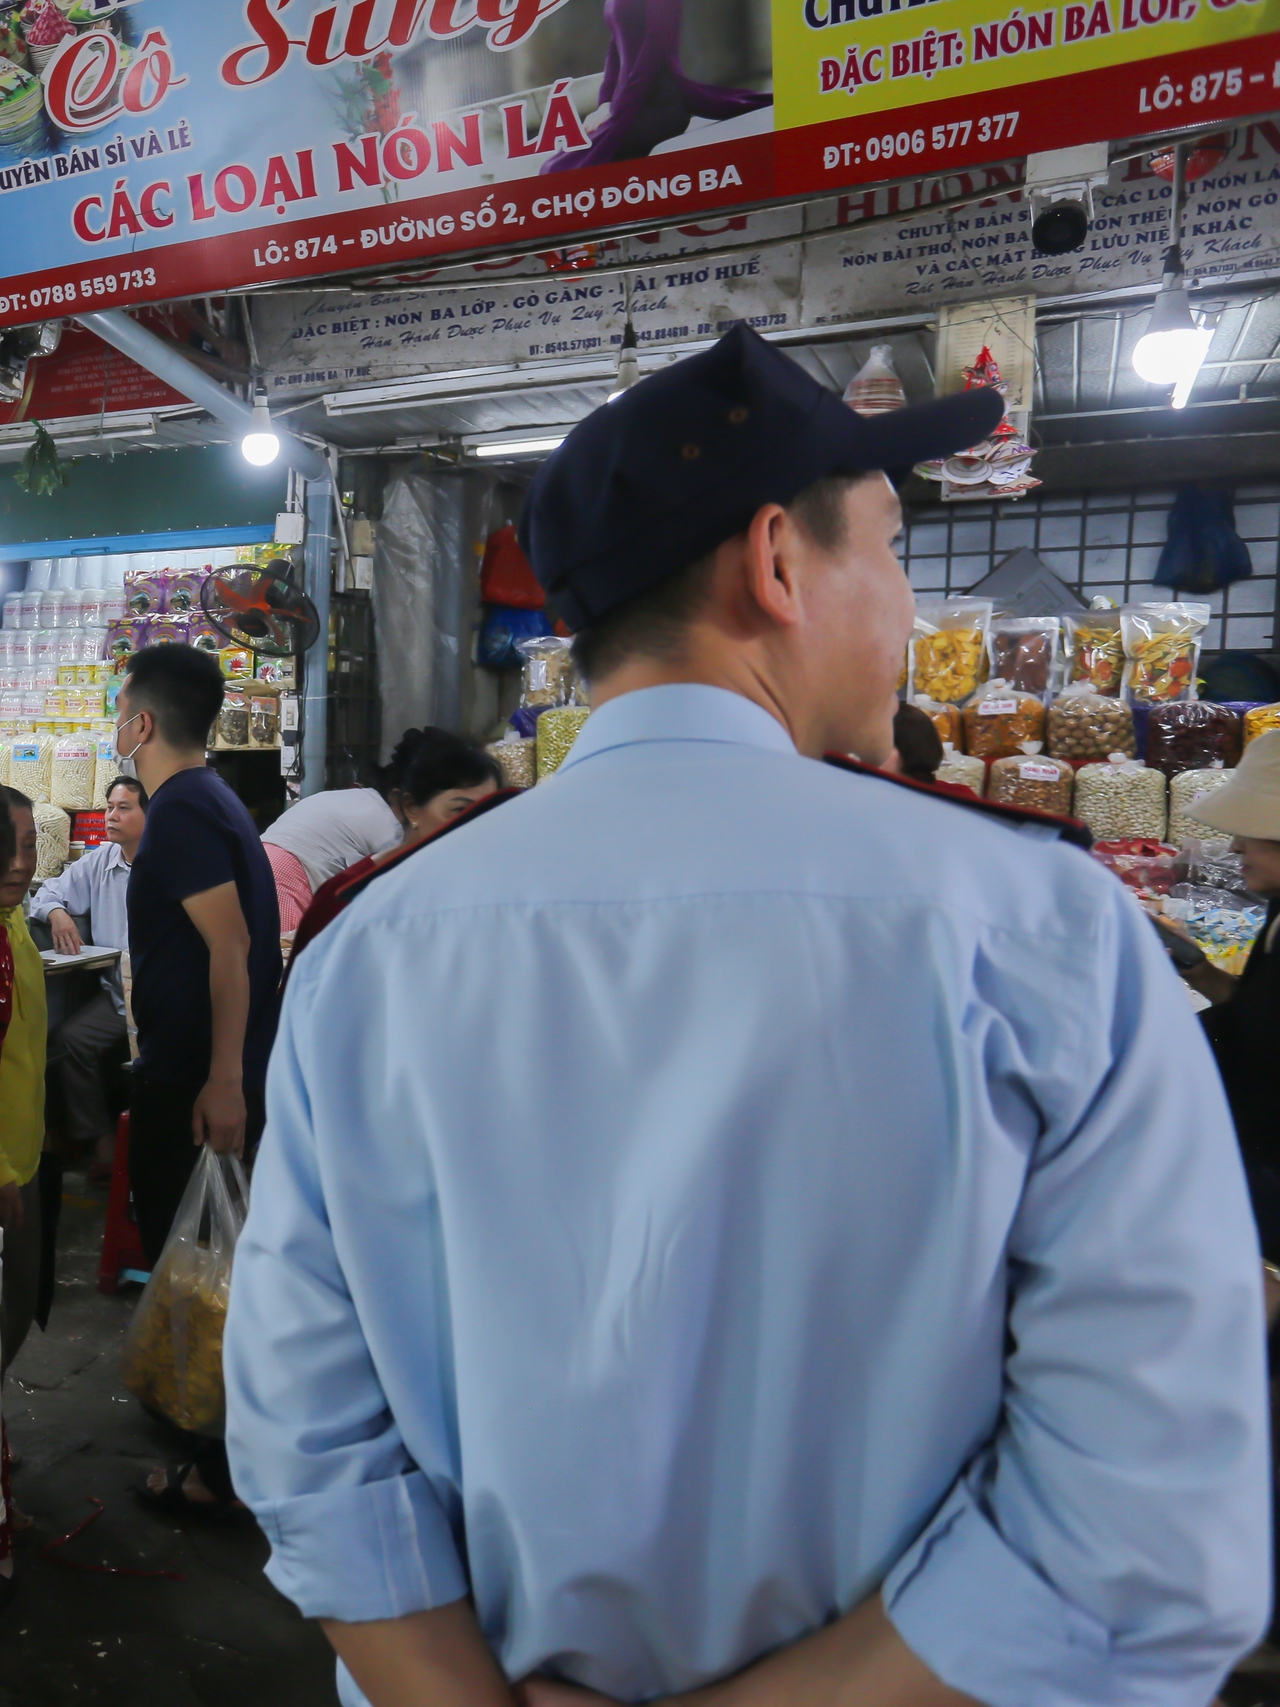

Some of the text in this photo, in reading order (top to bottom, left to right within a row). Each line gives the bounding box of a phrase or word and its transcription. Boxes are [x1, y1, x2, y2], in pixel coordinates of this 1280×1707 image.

[46, 25, 187, 129] Cô
[821, 0, 1111, 94] ĐẶC BIỆT: NÓN BA
[1139, 67, 1242, 113] LÔ: 875
[55, 144, 100, 179] BÁN
[105, 135, 128, 165] SỈ
[133, 128, 165, 158] VÀ
[168, 119, 192, 151] LẺ
[73, 82, 589, 243] CÁC LOẠI NÓN LÁ
[822, 111, 1020, 171] ĐT: 0906 577 377
[843, 247, 878, 268] NÓN
[882, 245, 912, 263] BÀI
[917, 240, 957, 258] THƠ,
[962, 232, 1000, 251] NÓN
[1005, 231, 1029, 244] BA
[1197, 196, 1242, 216] NÓN
[974, 209, 1013, 230] BÁN
[1102, 188, 1142, 208] CÁC
[1202, 172, 1247, 192] NÓN
[29, 281, 77, 309] 0788
[81, 273, 119, 298] 559
[120, 266, 157, 292] 733
[254, 239, 291, 268] LÔ:
[292, 232, 339, 258] 874
[360, 214, 456, 251] ĐƯỜNG
[459, 194, 497, 231] SỐ
[501, 201, 527, 227] 2,
[530, 187, 597, 220] CHỢ
[600, 171, 692, 207] ĐÔNG
[698, 163, 743, 189] BA
[905, 233, 1263, 296] Rất Hân Hạnh Phục Vụ Khách
[916, 217, 1253, 276] VÀ CÁC MẶT LƯU KHÁC
[292, 323, 327, 341] ĐẶC
[332, 316, 371, 336] BIỆT
[384, 307, 423, 328] NÓN
[430, 304, 455, 321] BA
[461, 297, 497, 317] LỚP
[513, 289, 540, 310] GÒ
[665, 267, 711, 288] THƠ
[715, 255, 762, 281] HUẾ
[360, 335, 392, 350] Hân
[399, 328, 441, 348] Hạnh
[492, 317, 531, 335] Phục
[538, 310, 562, 326] Vụ
[570, 304, 604, 322] Quý
